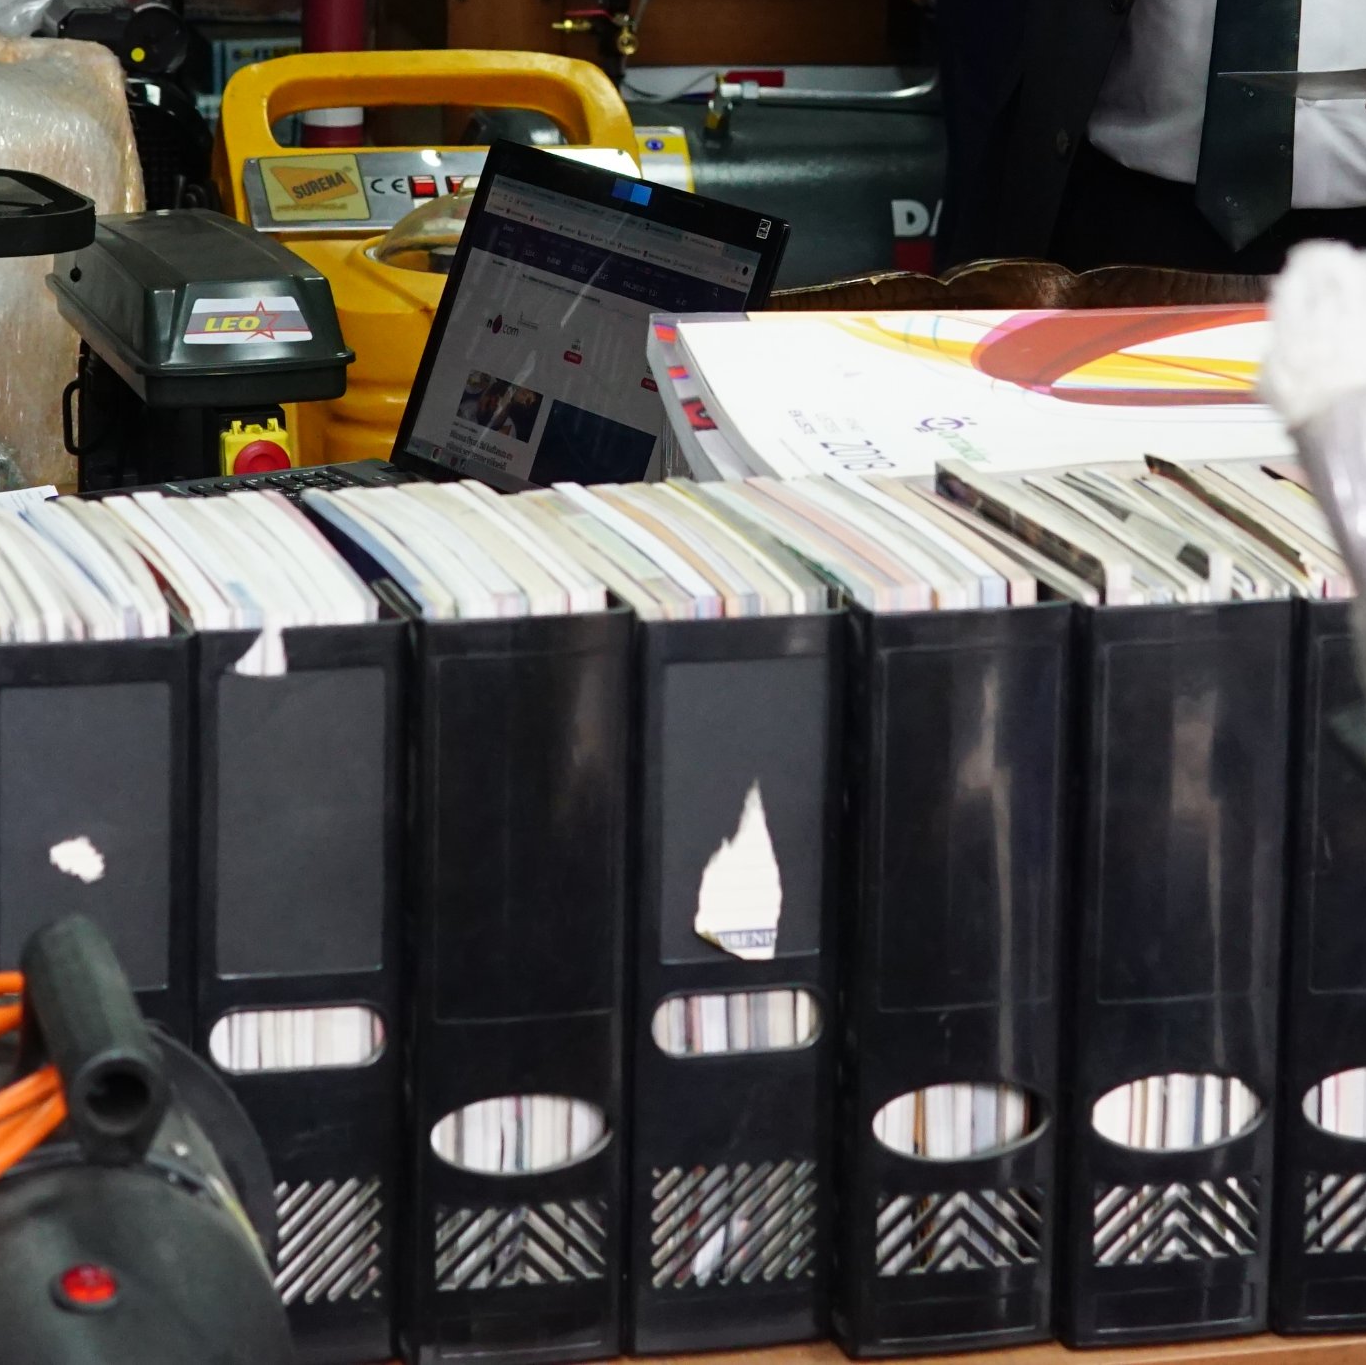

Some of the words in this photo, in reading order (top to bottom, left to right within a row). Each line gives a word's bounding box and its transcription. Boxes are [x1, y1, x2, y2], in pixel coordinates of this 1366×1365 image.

[291, 171, 347, 200] SURENA
[203, 315, 262, 332] LEO
[820, 439, 897, 471] 2018
